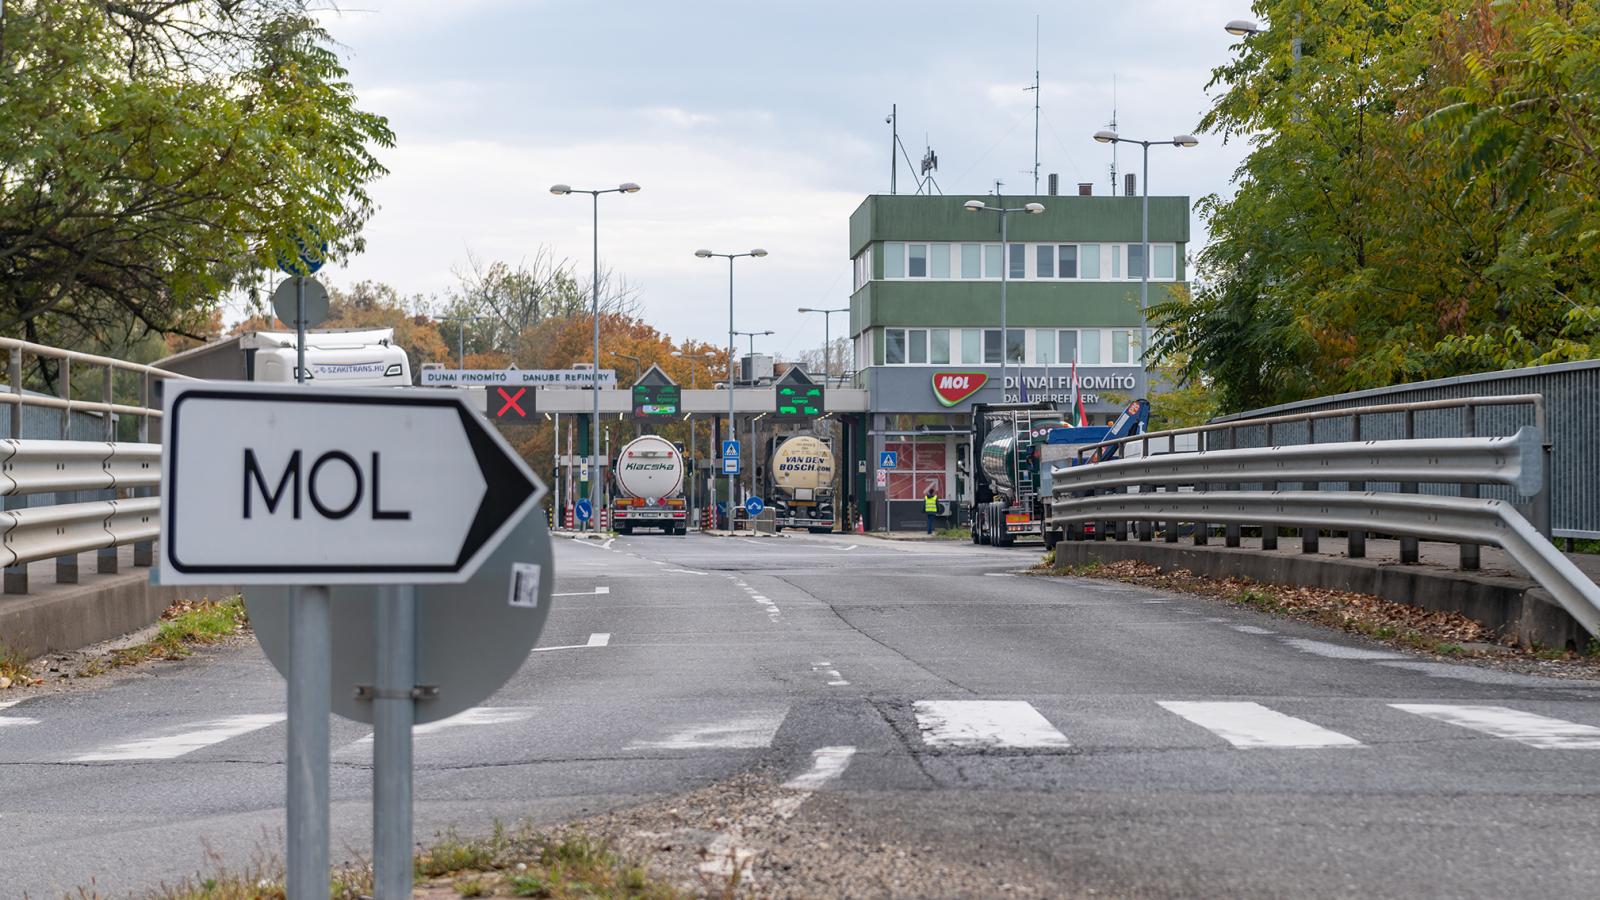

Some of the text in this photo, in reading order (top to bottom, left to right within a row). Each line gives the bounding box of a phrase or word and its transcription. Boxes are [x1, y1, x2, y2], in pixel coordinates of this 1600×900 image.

[428, 372, 507, 382] DUNAI FINOMÍTÓ
[523, 373, 560, 382] DANUBE
[939, 376, 970, 389] MOL
[1004, 394, 1100, 403] DAUBE REFIERY
[786, 456, 825, 464] VAN DEN
[625, 463, 675, 471] Klacska
[243, 447, 412, 520] MOL
